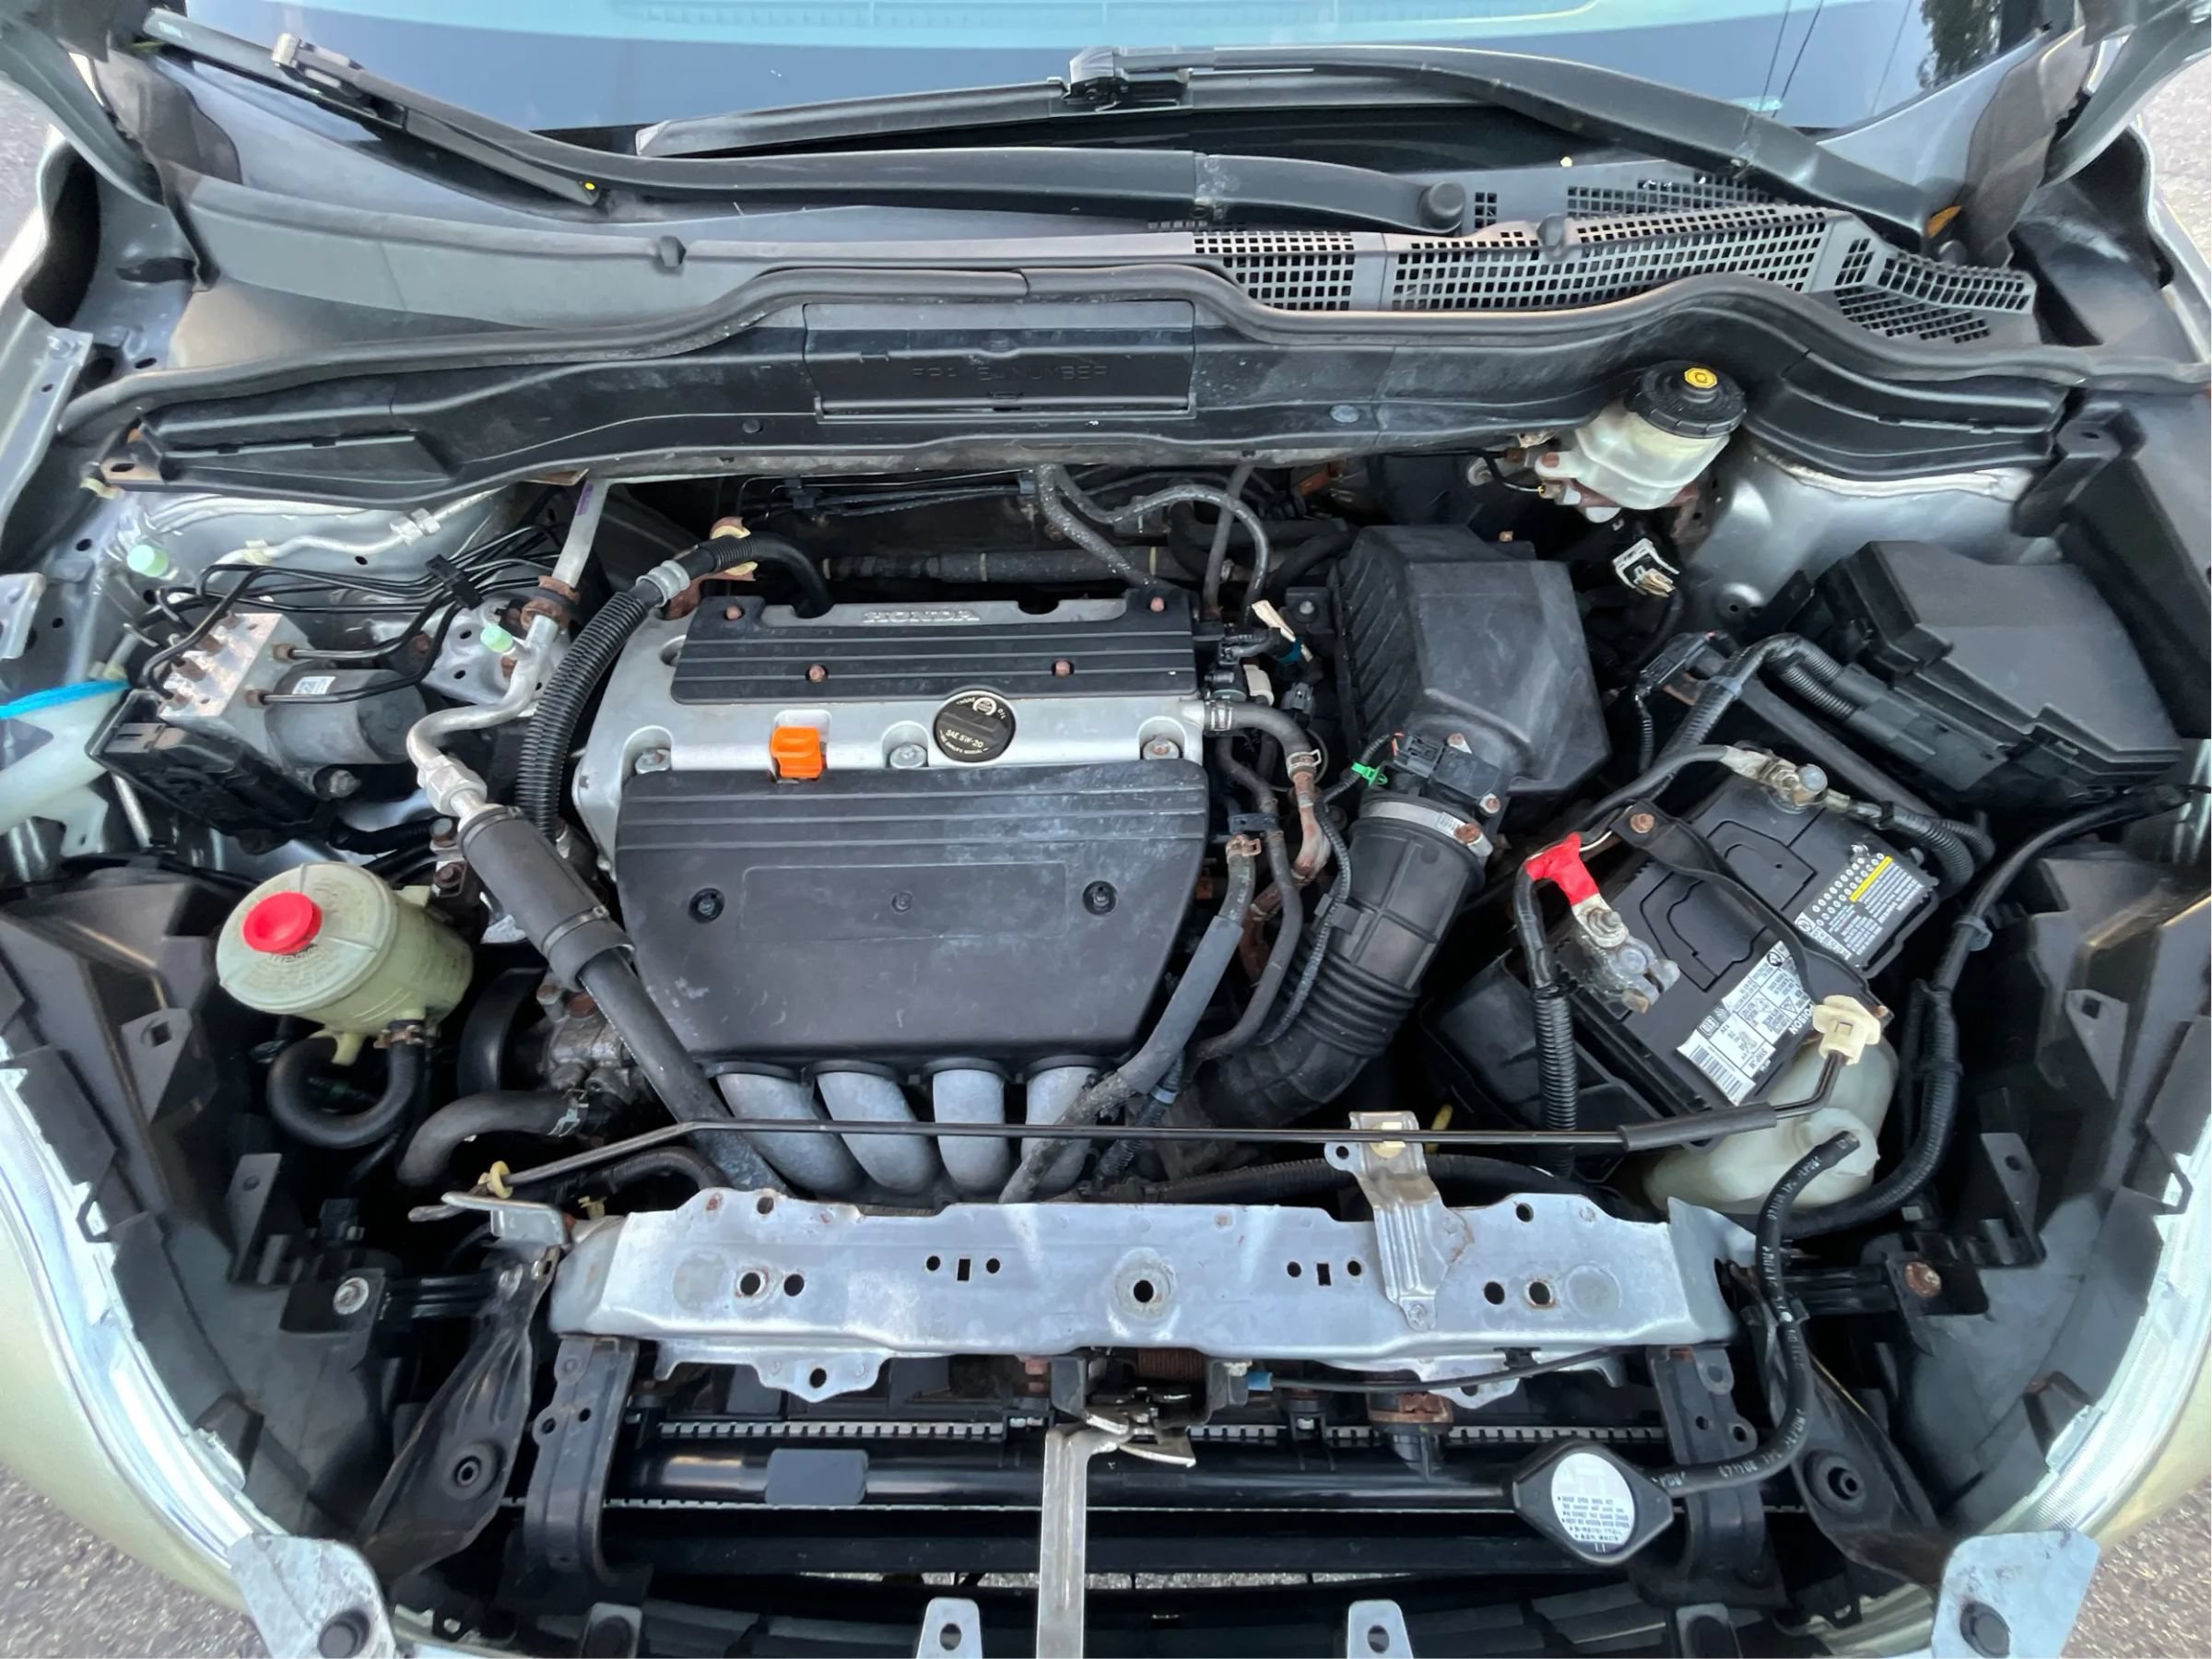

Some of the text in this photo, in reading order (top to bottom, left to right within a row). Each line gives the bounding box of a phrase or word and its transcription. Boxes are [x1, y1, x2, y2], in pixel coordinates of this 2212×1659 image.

[863, 609, 980, 624] HONDA
[946, 729, 984, 748] SAE 5W-20
[1788, 1003, 1815, 1034] POISON
